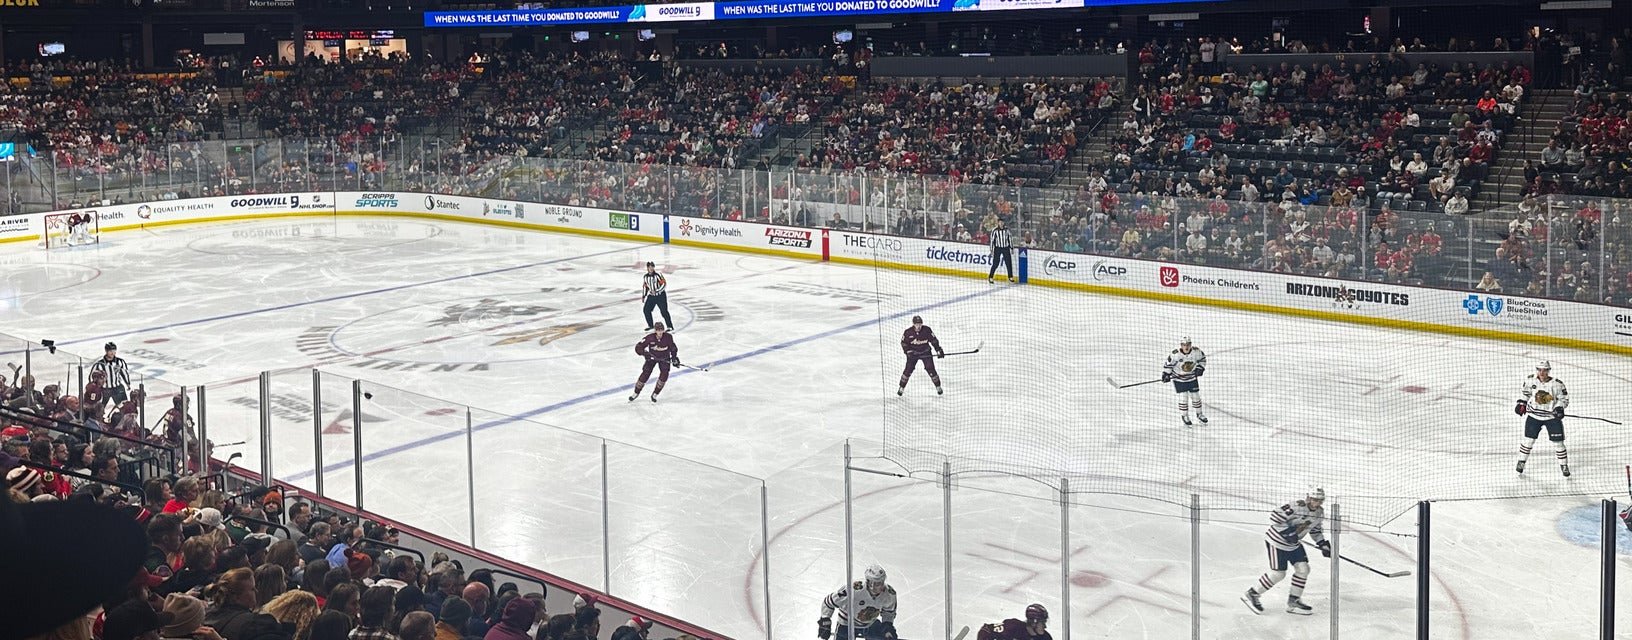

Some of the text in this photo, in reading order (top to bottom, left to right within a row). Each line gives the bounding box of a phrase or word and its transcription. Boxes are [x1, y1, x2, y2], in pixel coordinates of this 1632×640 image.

[659, 6, 694, 15] GOODWILL
[724, 0, 940, 15] WHEN WAS THE LAST TIME YOU DONATED TO GOODWILL?
[435, 15, 458, 23] WHEN
[460, 15, 475, 23] WAS
[493, 14, 510, 22] LAST
[531, 13, 546, 21] YOU
[547, 12, 574, 20] DONATED
[576, 12, 583, 20] TO
[584, 11, 619, 19] GOODWILL?
[230, 196, 287, 208] GOODWILL
[355, 199, 398, 208] SPORTS
[437, 199, 460, 210] Stantec
[153, 205, 185, 214] EQUALITY
[545, 207, 583, 218] NOBLE GROUND
[695, 224, 718, 236] Dignity
[768, 229, 807, 239] ARIZONA
[771, 237, 808, 247] SPORTS
[1048, 259, 1076, 270] ACP
[1097, 265, 1127, 276] ACP
[1182, 274, 1260, 291] Phoenix Children's
[1347, 288, 1409, 306] COYOTES
[1506, 298, 1546, 309] BlueCross
[1506, 306, 1548, 316] BlueShield
